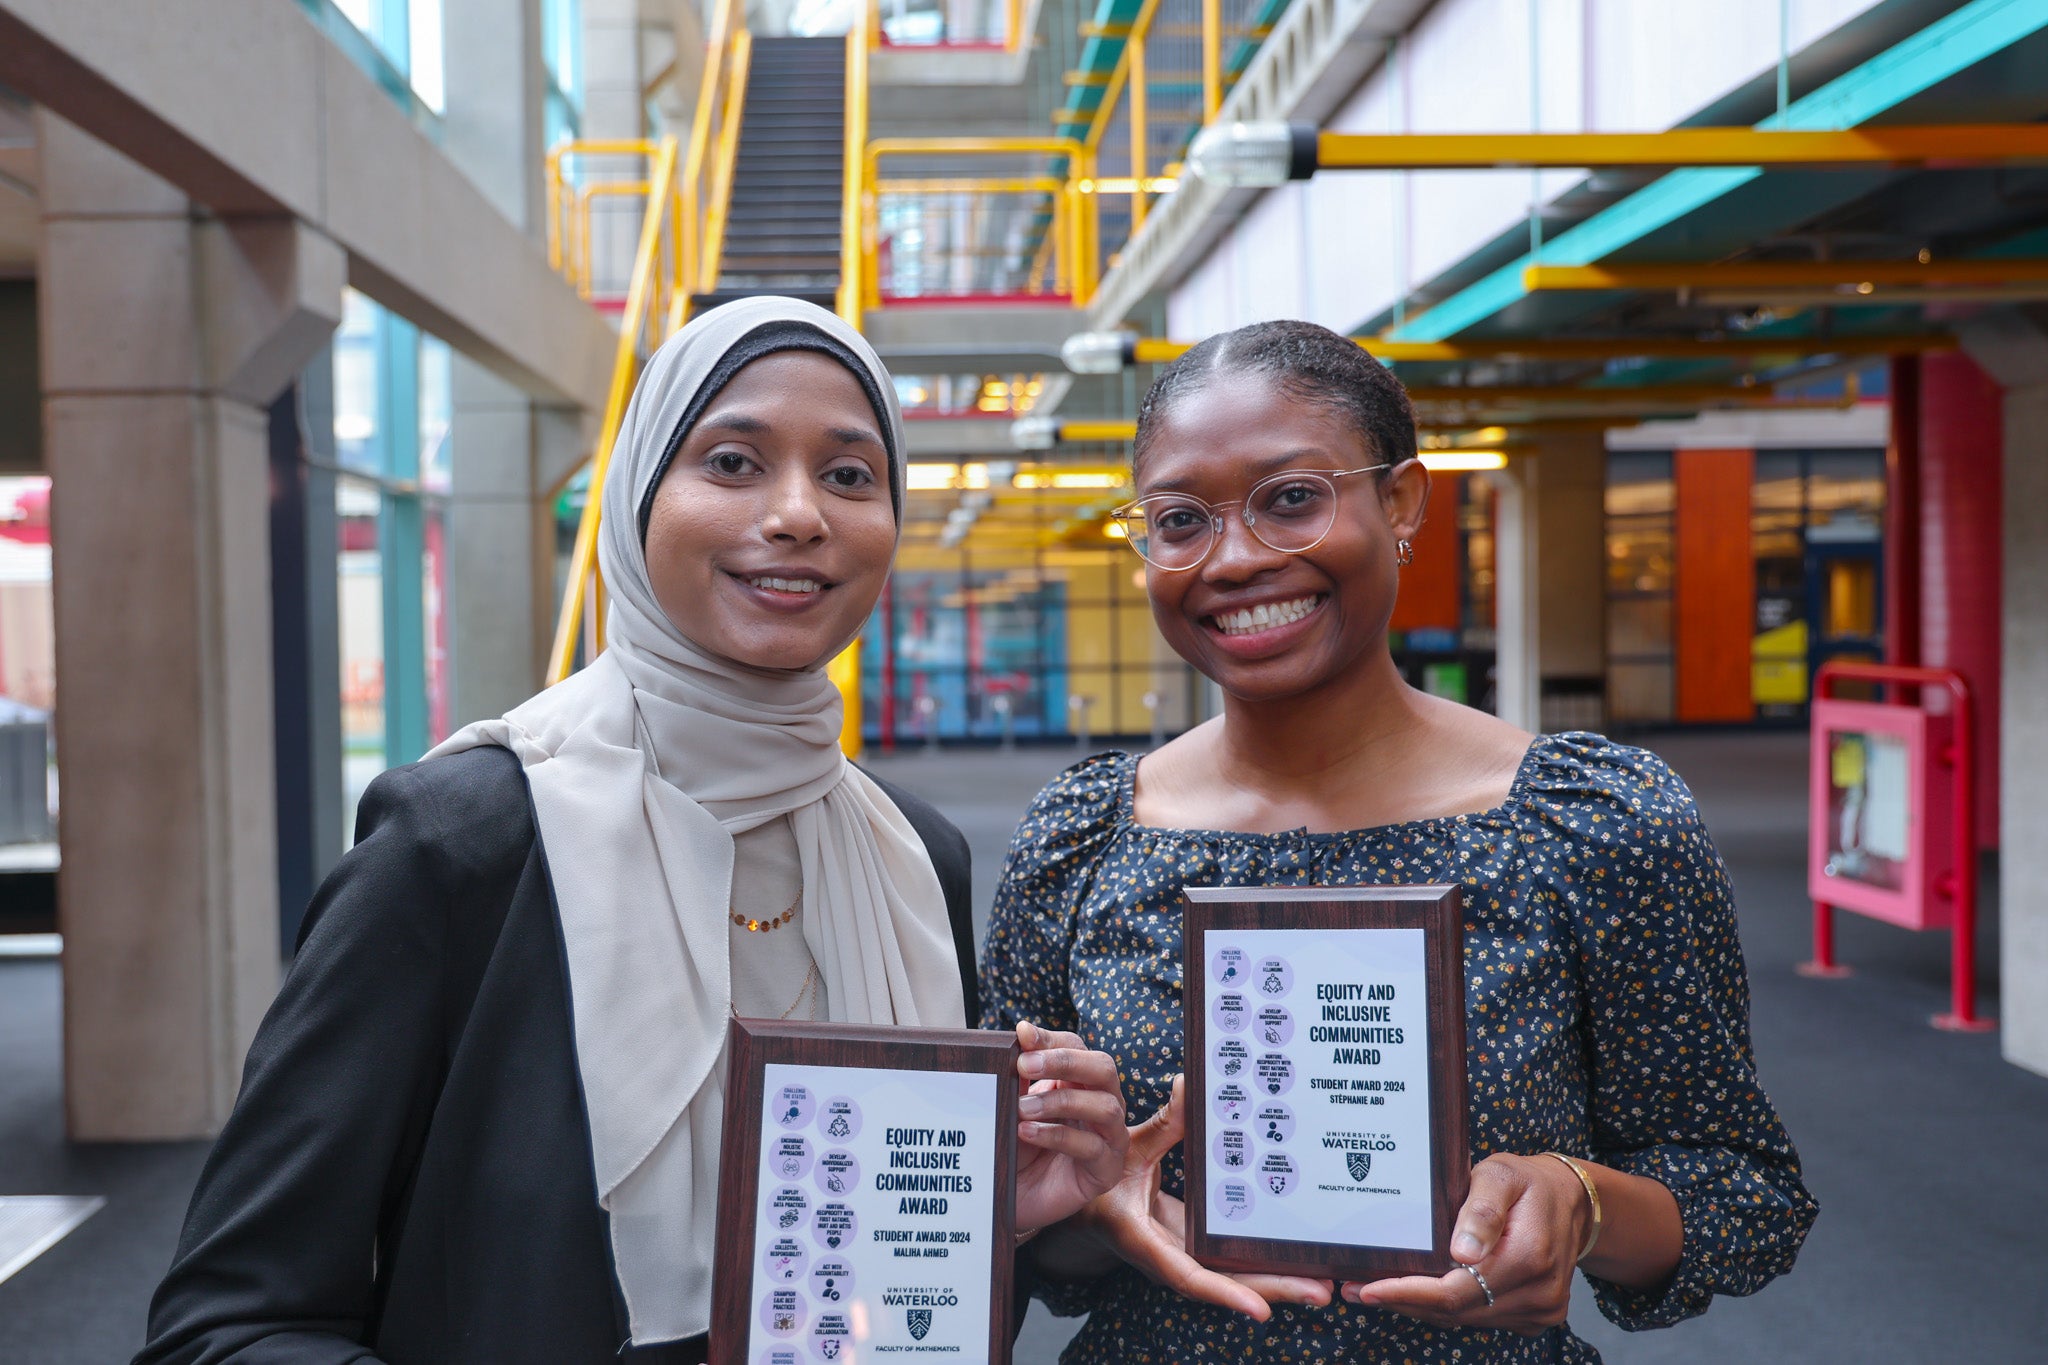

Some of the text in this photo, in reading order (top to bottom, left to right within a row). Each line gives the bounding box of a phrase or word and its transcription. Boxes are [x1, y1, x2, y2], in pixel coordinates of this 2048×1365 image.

[1317, 984, 1395, 1002] EQUITY AND
[1322, 1006, 1391, 1022] INCLUSIVE
[1310, 1027, 1404, 1044] COMMUNITIES
[1333, 1048, 1381, 1064] AWARD
[1310, 1079, 1405, 1092] STUDENT AWARD 2024
[1370, 1096, 1384, 1106] ABO
[886, 1128, 966, 1148] EQUITY AND
[1322, 1138, 1396, 1151] WATERLOO
[890, 1151, 960, 1170] INCLUSIVE
[876, 1173, 972, 1192] COMMUNITIES
[1357, 1187, 1401, 1195] MATHEMATICS
[899, 1198, 948, 1215] AWARD
[874, 1230, 971, 1243] STUDENT AWARD 2024
[894, 1248, 948, 1258] MALIHA AHMED
[883, 1295, 958, 1306] WATERLOO
